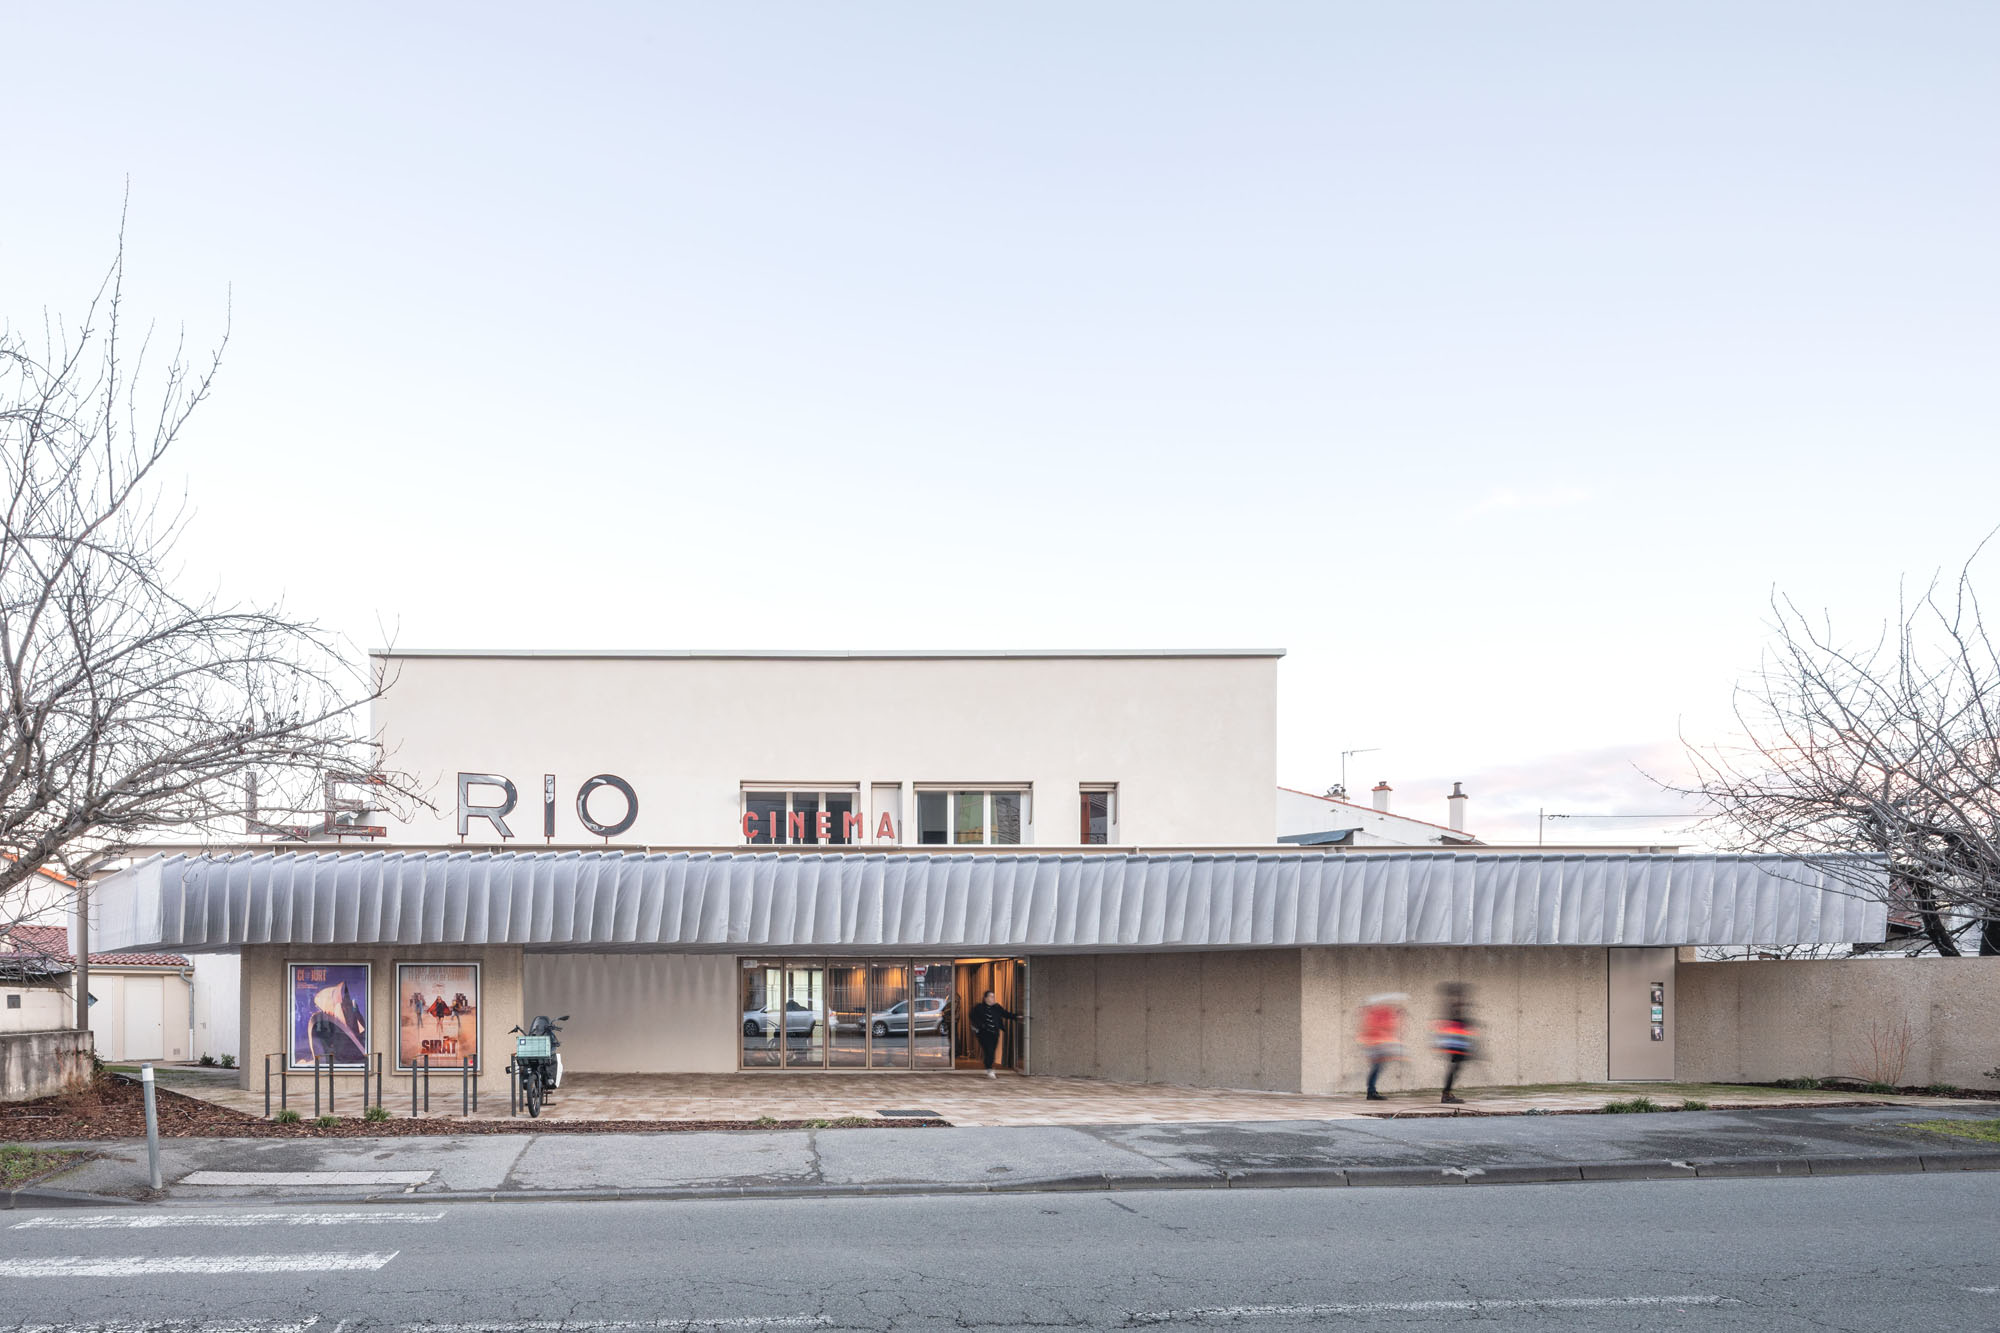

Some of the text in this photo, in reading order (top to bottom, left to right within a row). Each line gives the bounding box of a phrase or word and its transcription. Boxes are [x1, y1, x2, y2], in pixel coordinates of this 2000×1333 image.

[246, 771, 639, 838] LE RIO
[742, 811, 896, 839] CINEMA
